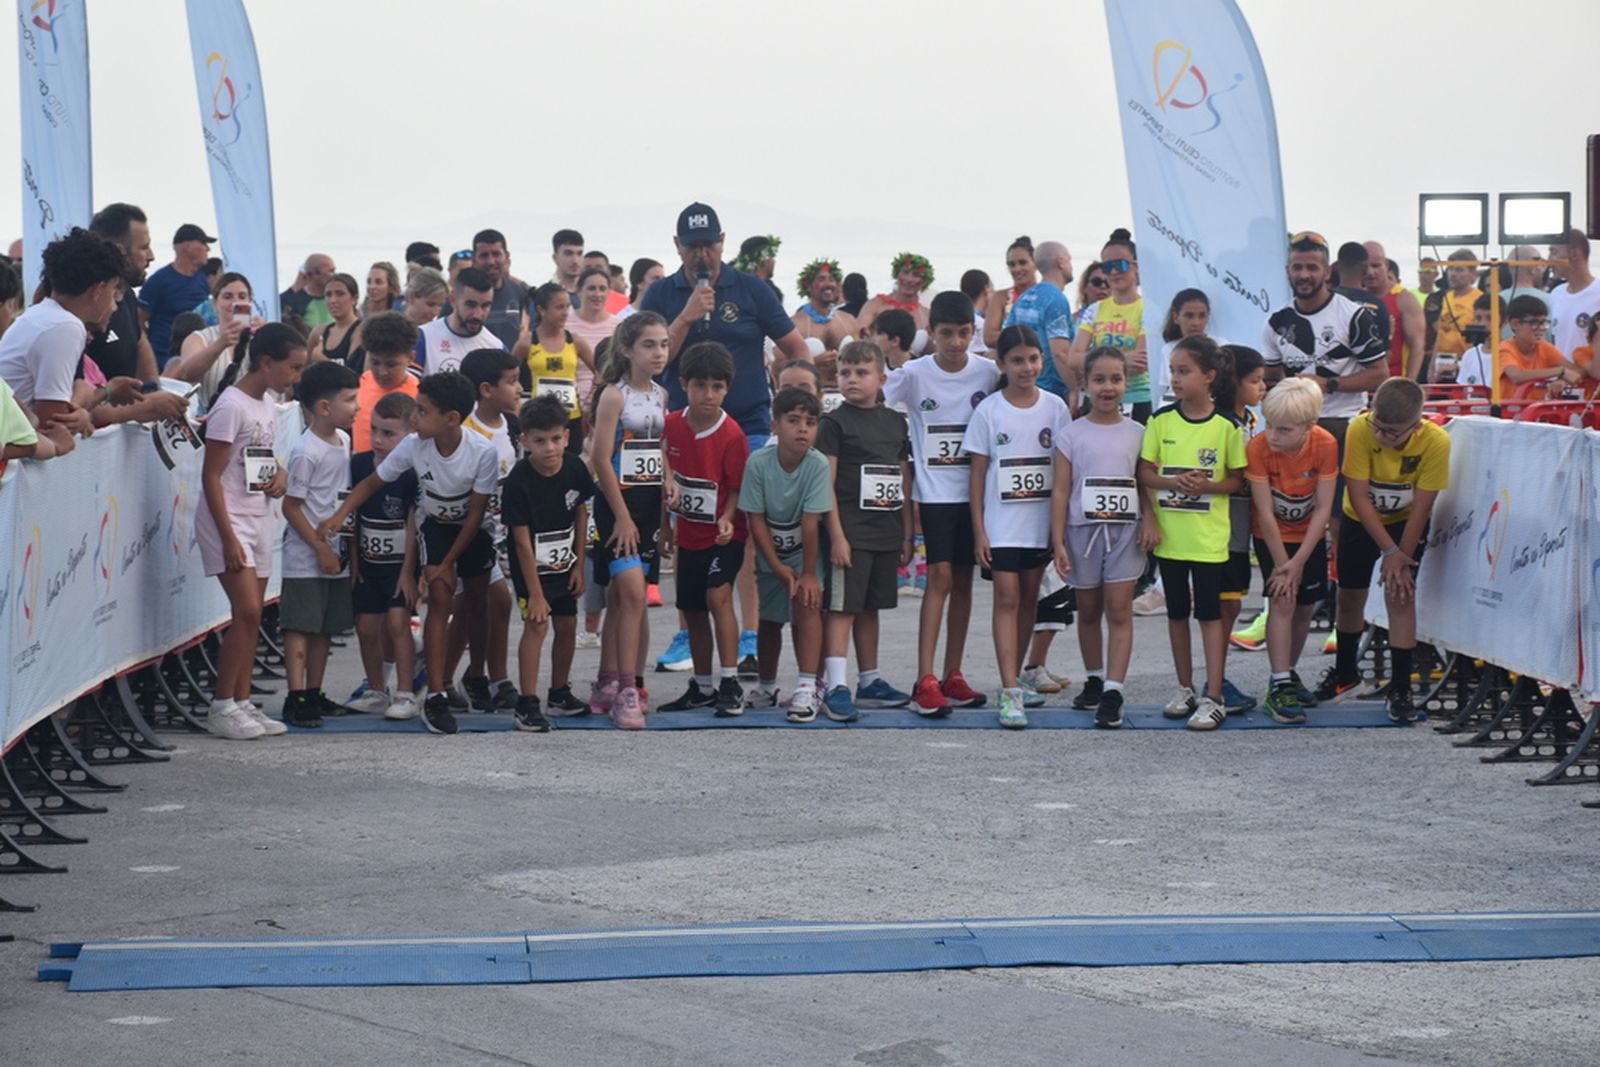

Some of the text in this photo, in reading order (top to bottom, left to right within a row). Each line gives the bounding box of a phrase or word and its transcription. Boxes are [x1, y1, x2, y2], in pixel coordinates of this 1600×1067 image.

[688, 214, 709, 229] HH
[1011, 473, 1045, 491] 369
[1095, 495, 1129, 512] 350
[362, 534, 394, 554] 385
